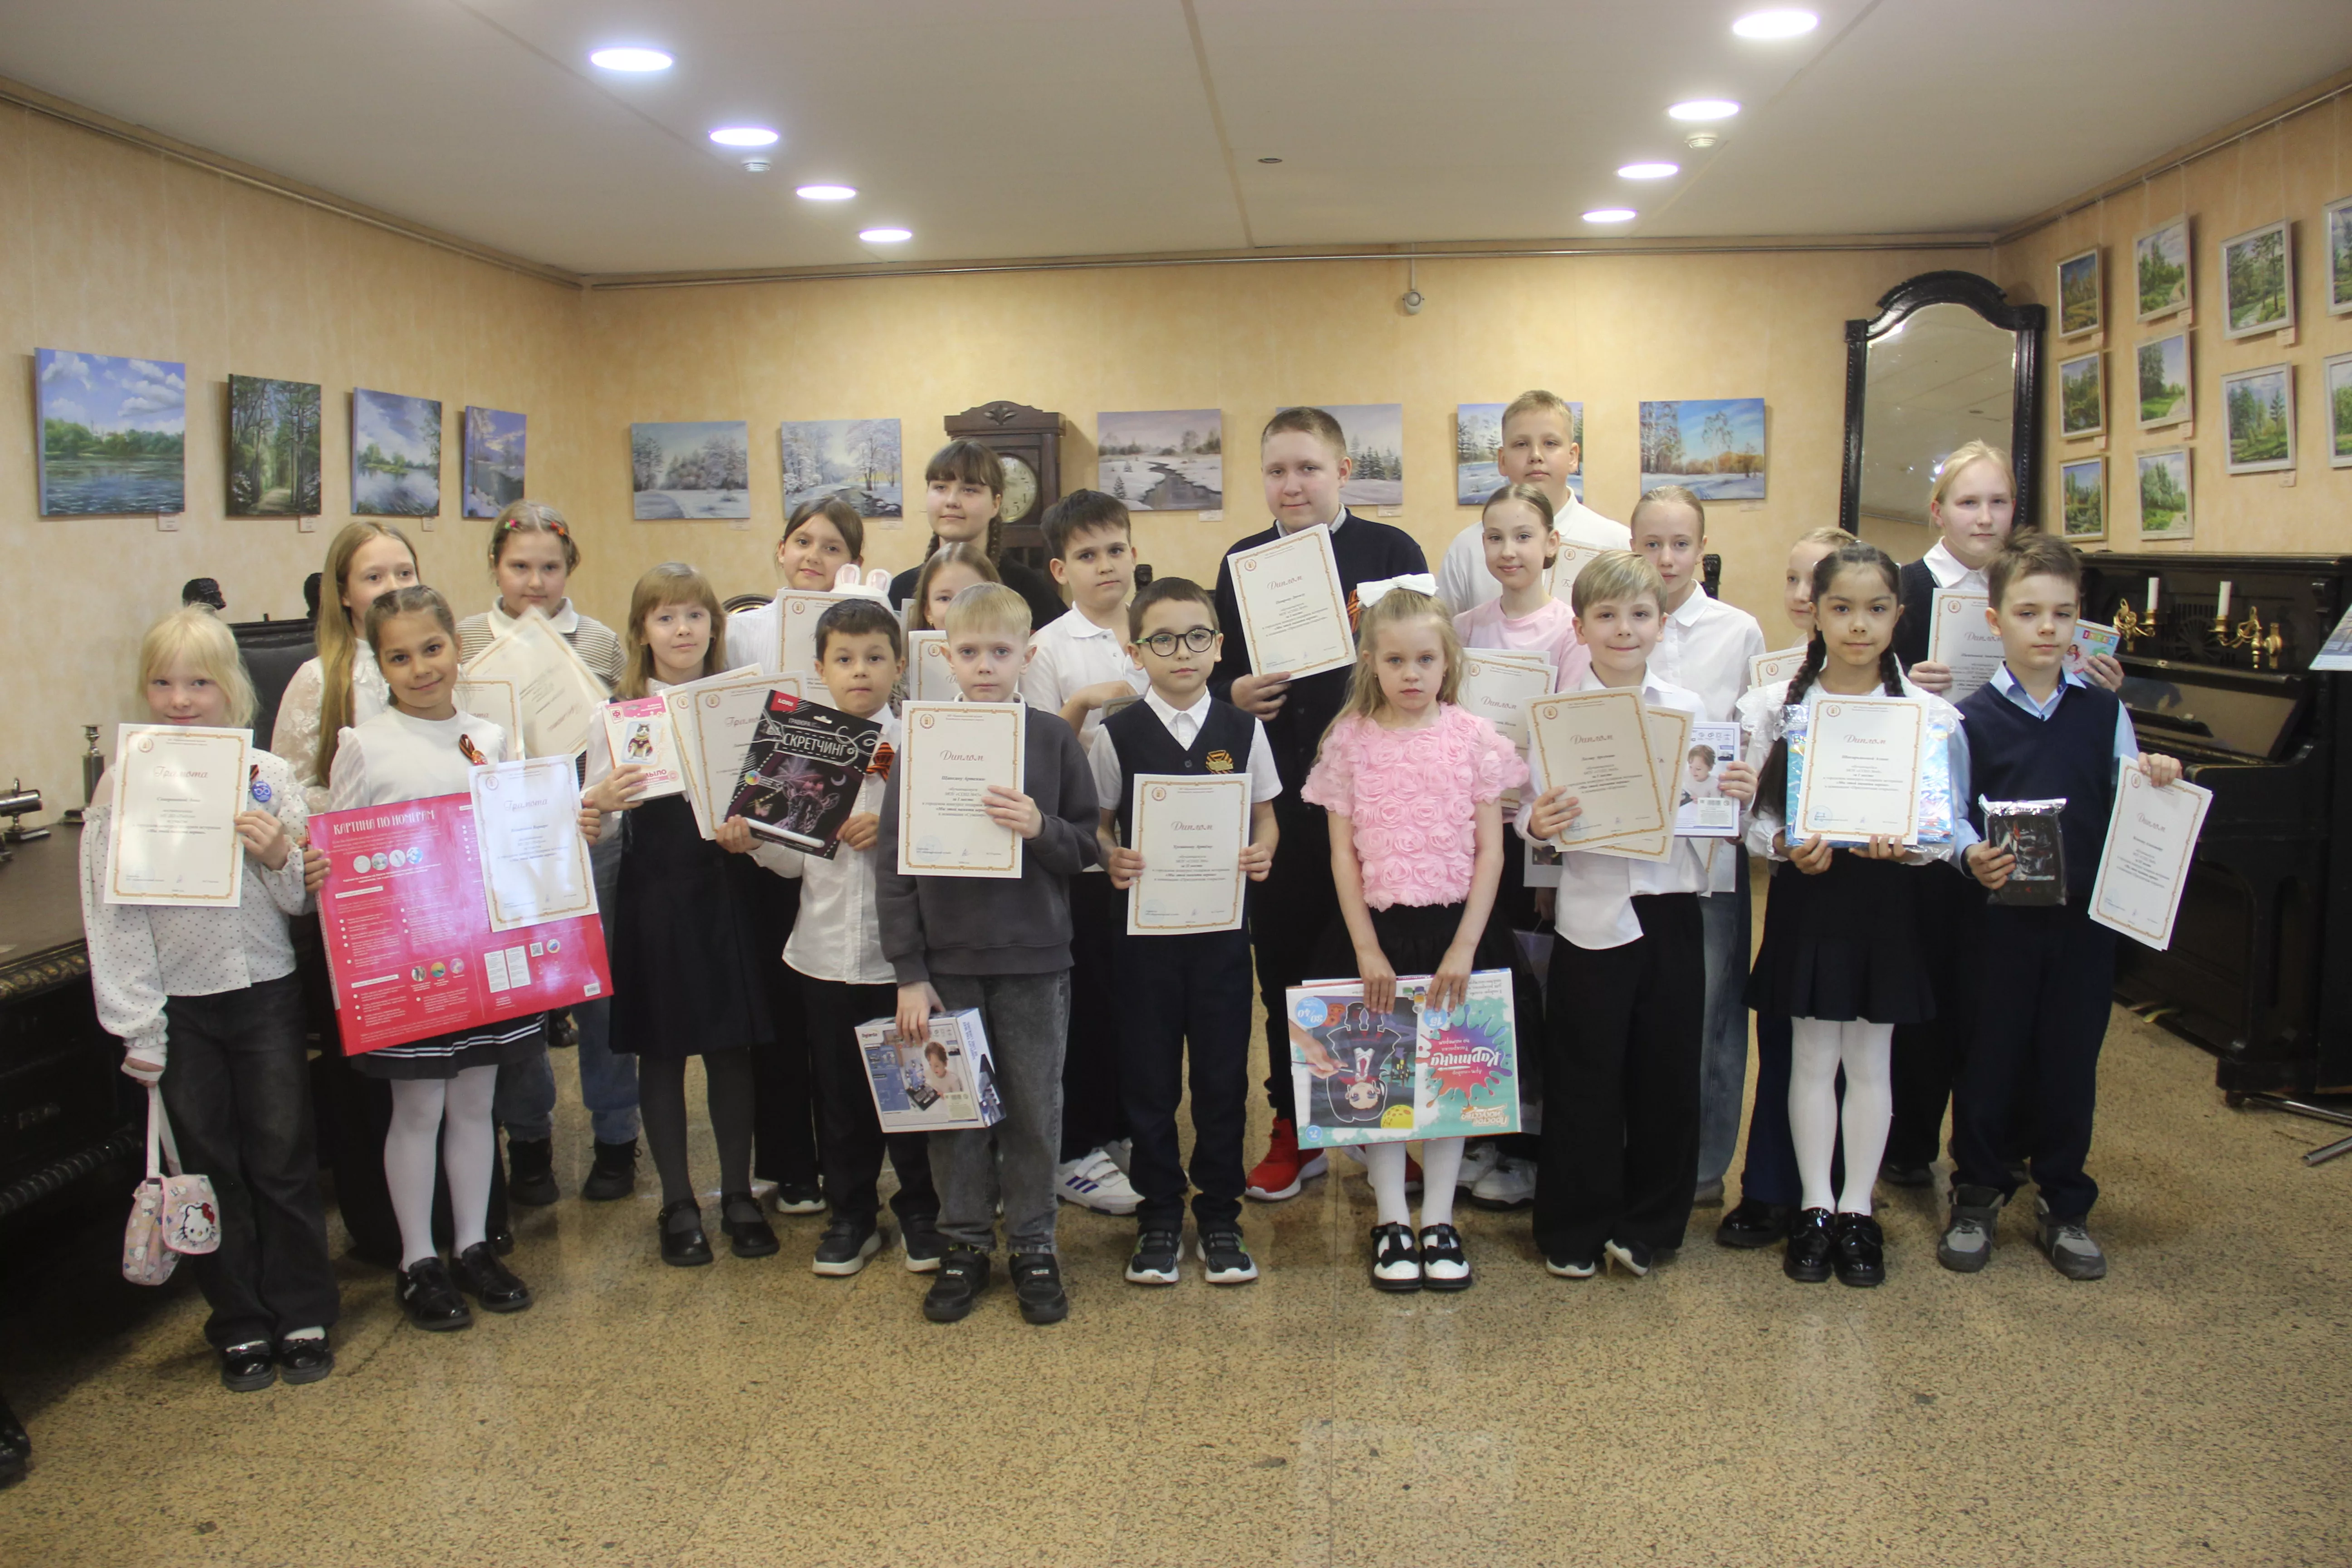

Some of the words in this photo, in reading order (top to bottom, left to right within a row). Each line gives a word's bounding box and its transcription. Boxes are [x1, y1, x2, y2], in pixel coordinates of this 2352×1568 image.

[1267, 576, 1303, 590] Диплом
[1480, 696, 1517, 710] Диплом
[725, 717, 759, 727] Грамо
[783, 733, 848, 757] СКРЕТЧИНГ
[1570, 735, 1613, 745] Диплом
[1843, 734, 1886, 745] Диплом
[940, 750, 984, 761] Диплом
[333, 818, 375, 835] КАРТИНА
[377, 816, 391, 828] ПО
[1171, 821, 1213, 831] Диплом
[1430, 1046, 1501, 1068] Картина
